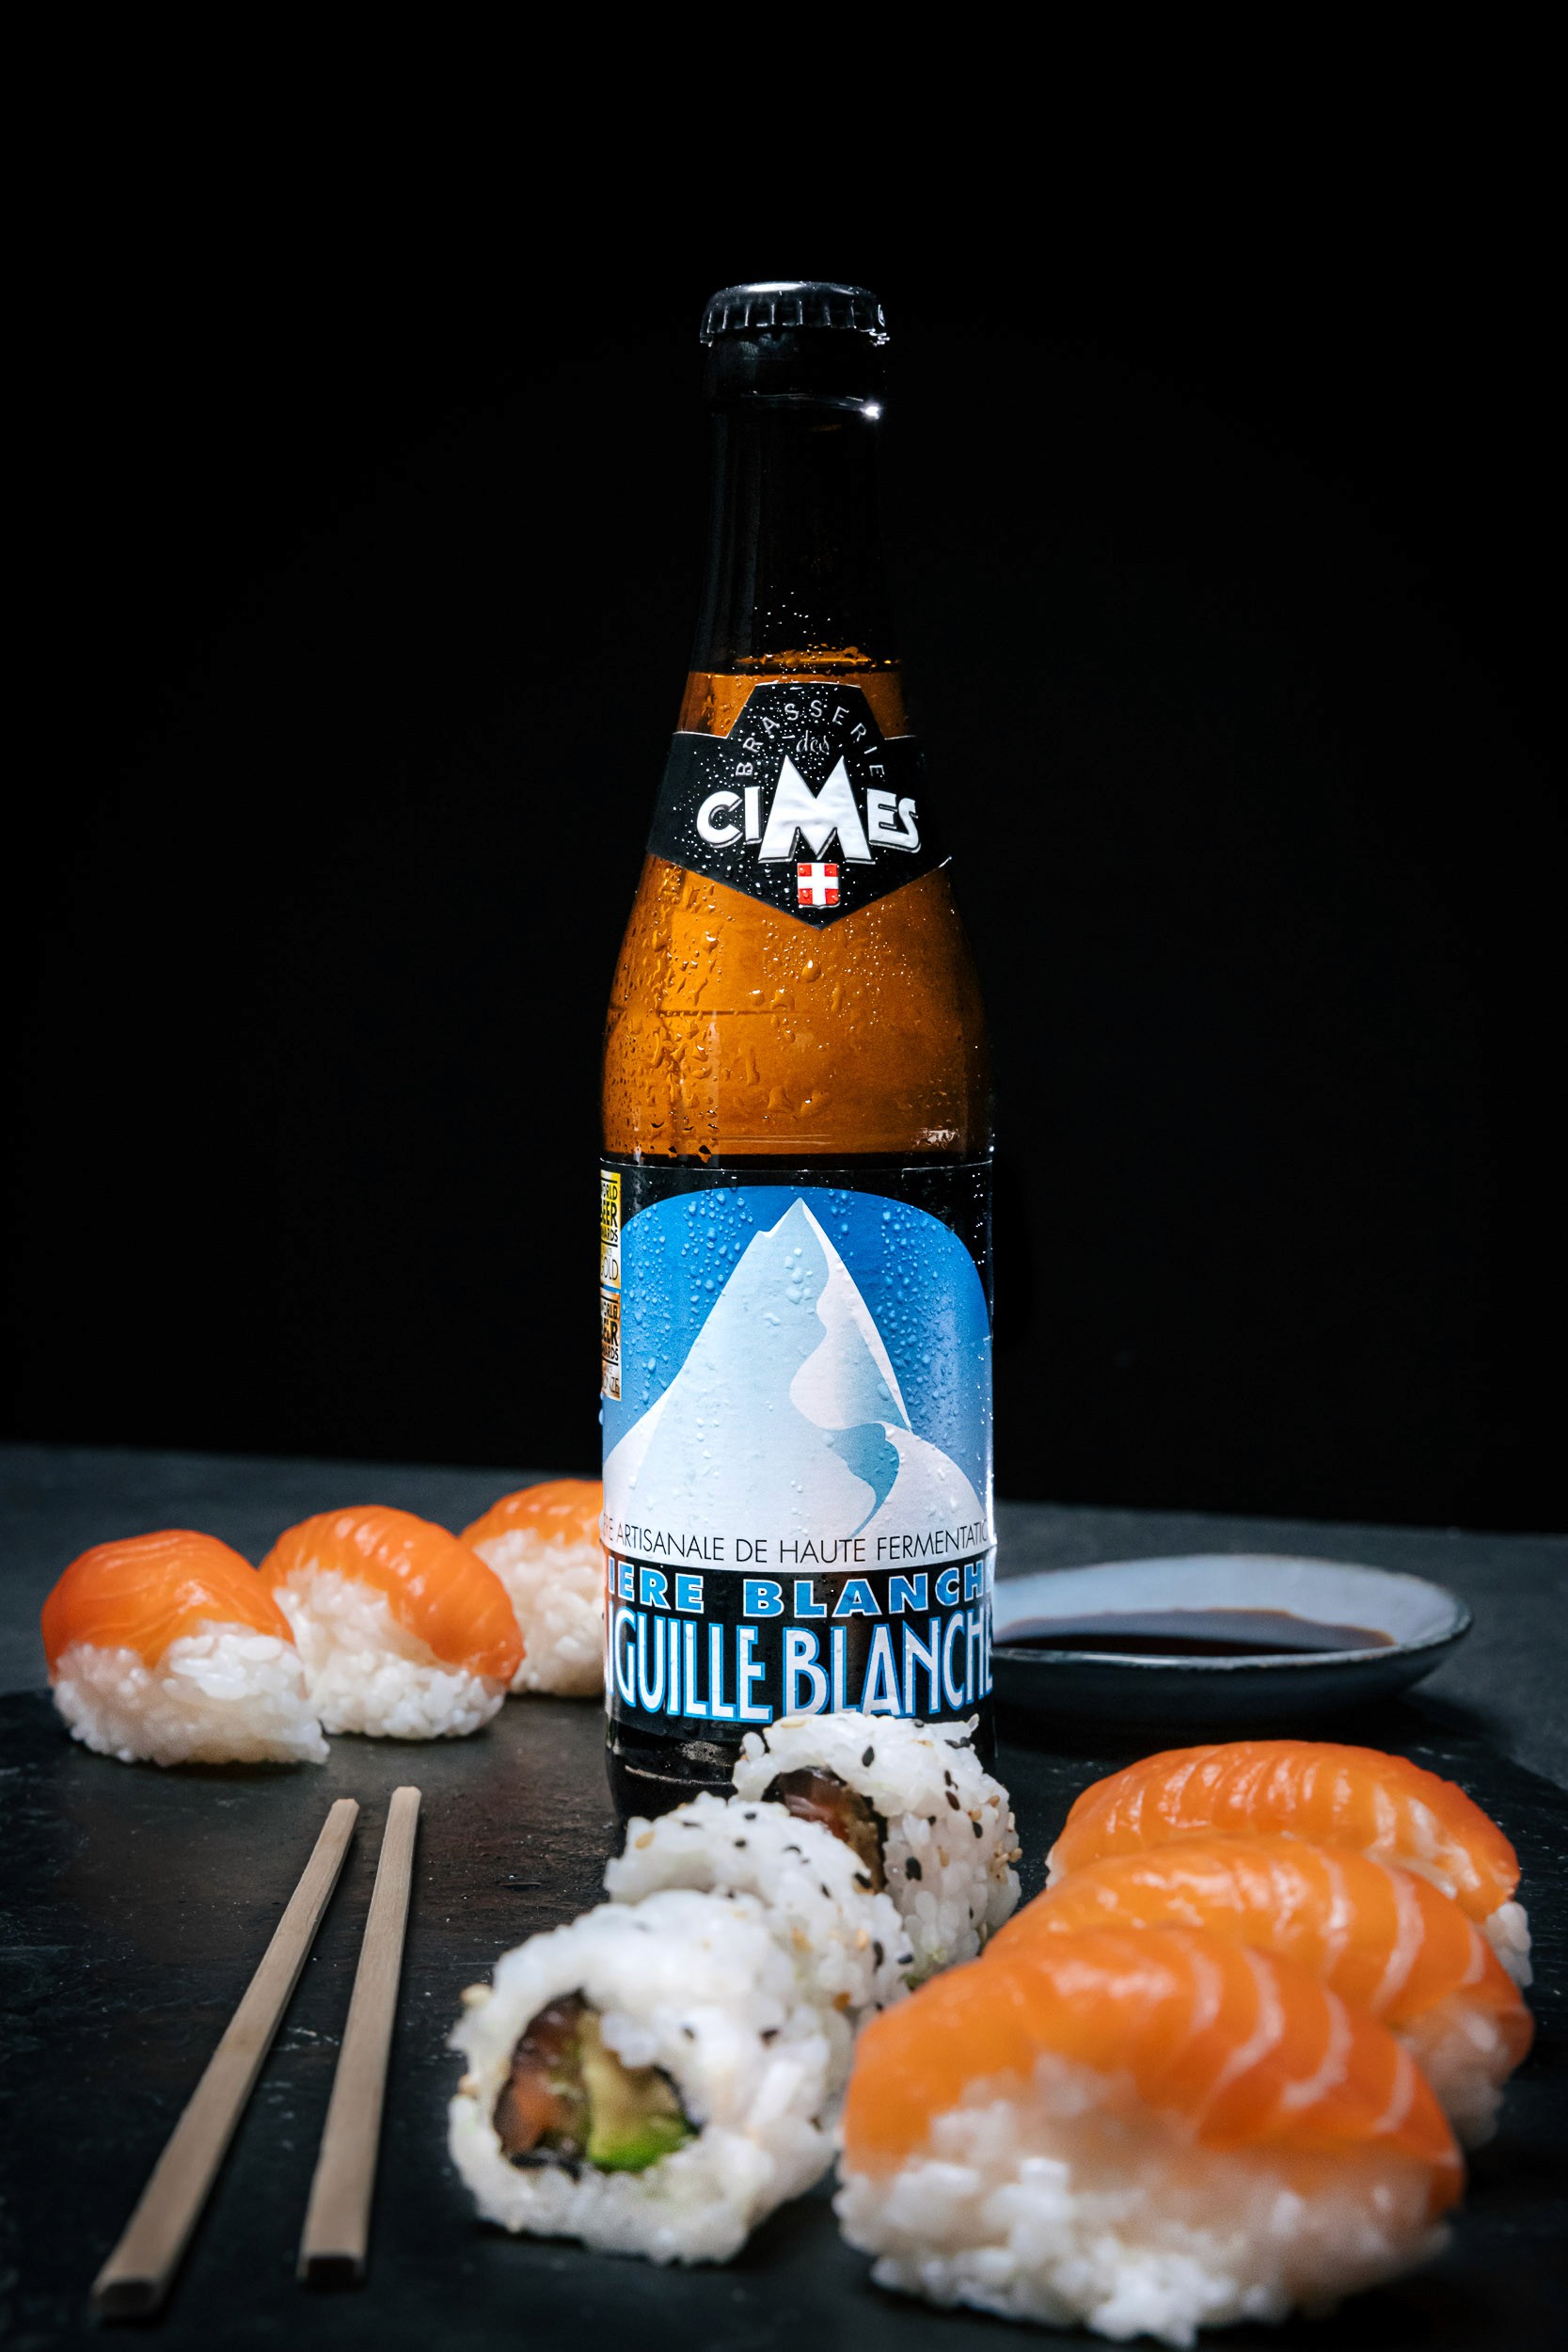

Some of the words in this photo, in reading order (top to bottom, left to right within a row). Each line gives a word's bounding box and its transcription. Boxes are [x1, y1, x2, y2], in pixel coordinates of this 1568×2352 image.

[736, 700, 885, 777] BRASSERIE
[796, 730, 830, 754] des
[696, 755, 921, 865] CIMES
[601, 1183, 618, 1200] ORLD
[601, 1200, 618, 1228] EER
[601, 1301, 618, 1320] ORLD
[601, 1317, 619, 1347] EER
[616, 1521, 724, 1561] ARTISANALE
[736, 1538, 768, 1563] DE
[780, 1538, 866, 1564] HAUTE
[604, 1599, 773, 1724] IGUILLE
